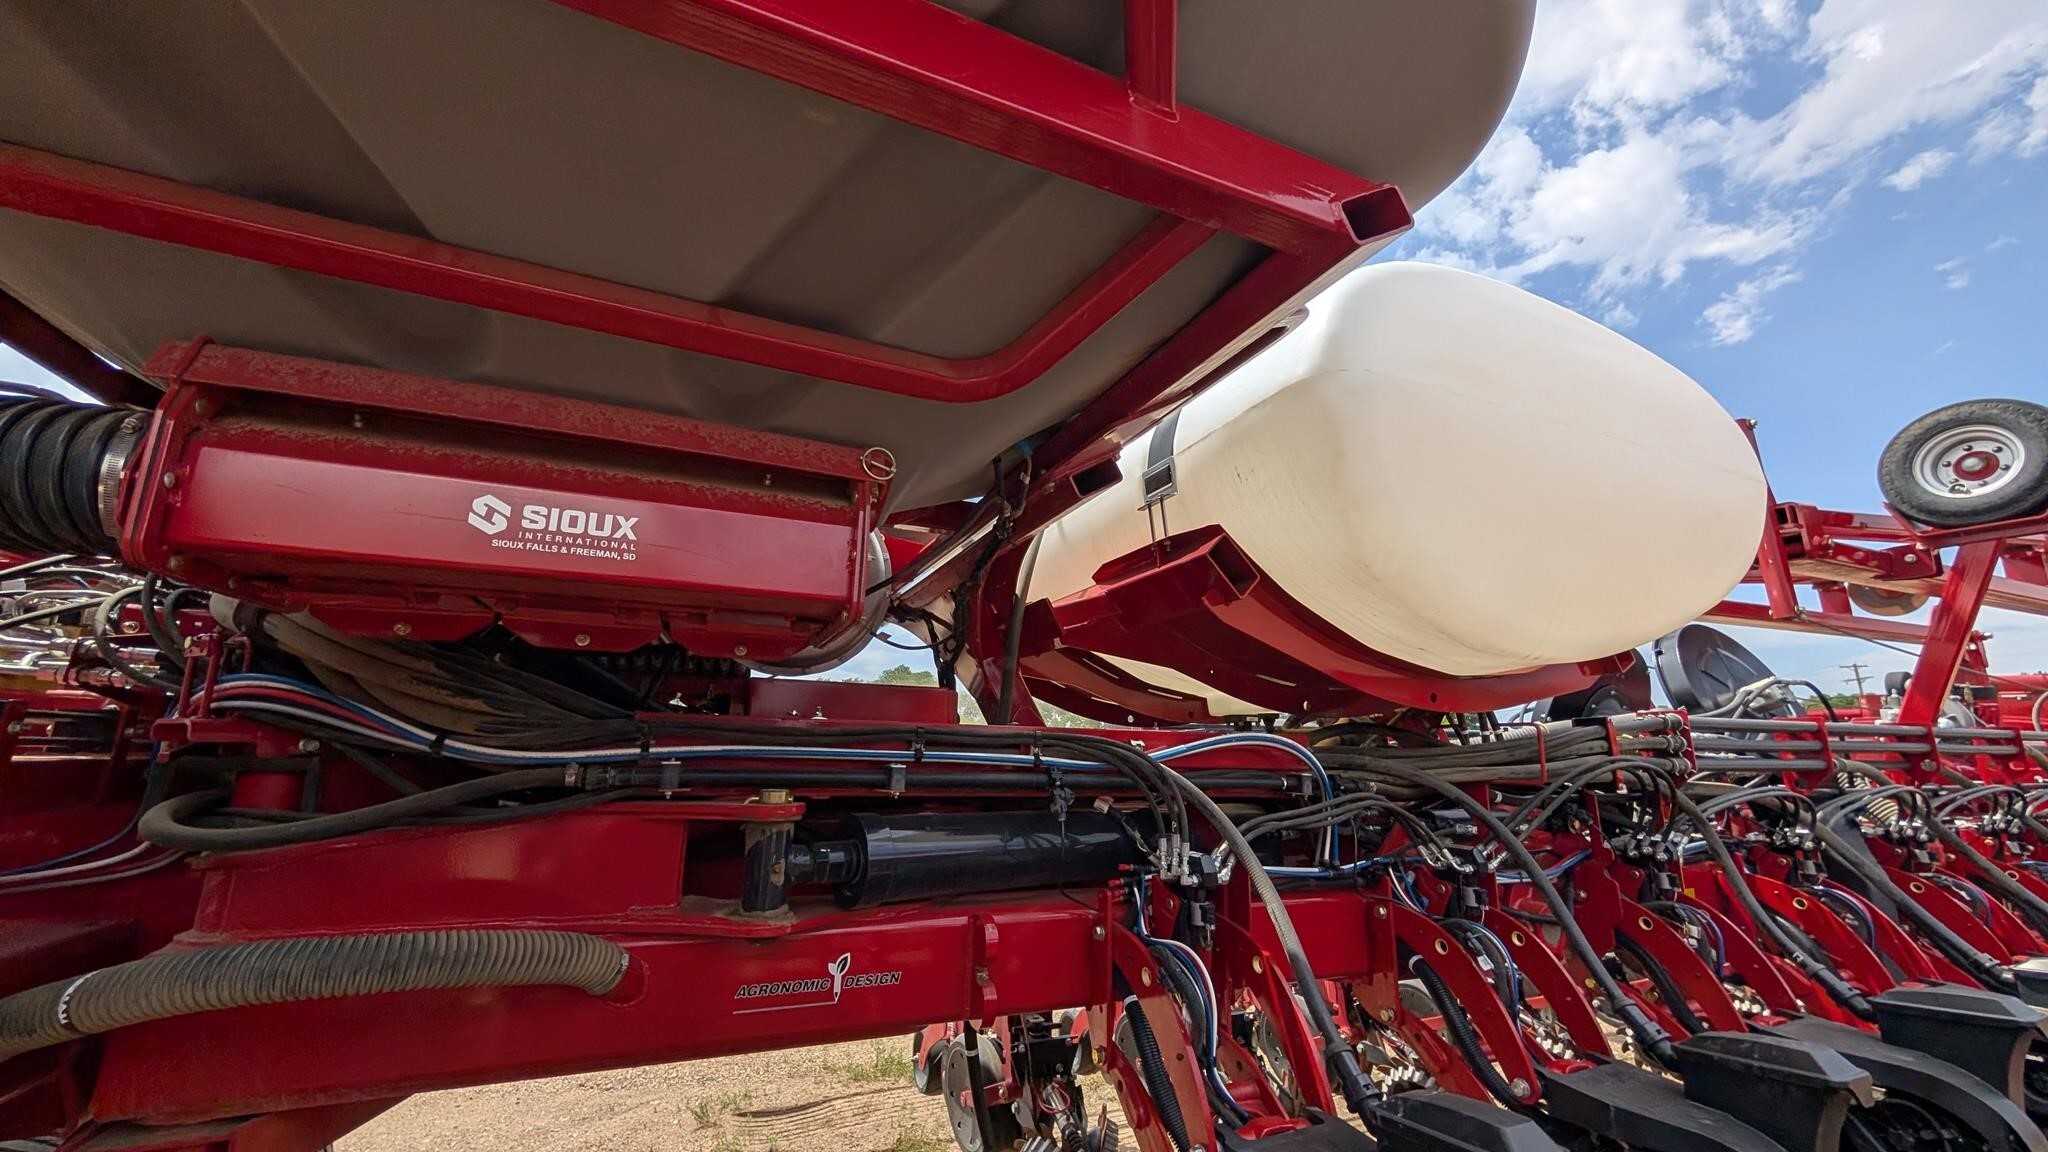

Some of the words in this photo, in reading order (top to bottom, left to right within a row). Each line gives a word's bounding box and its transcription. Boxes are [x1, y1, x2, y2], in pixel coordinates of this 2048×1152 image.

[521, 504, 640, 541] SIOUX
[491, 538, 524, 550] SIOUX
[526, 542, 558, 553] FALLS
[559, 546, 568, 554] &
[570, 547, 621, 560] FREEMAN,
[622, 552, 636, 561] SD
[518, 531, 637, 551] INTERNATIONAL
[734, 978, 831, 999] AGRONOMIC
[843, 971, 902, 989] DESIGN
